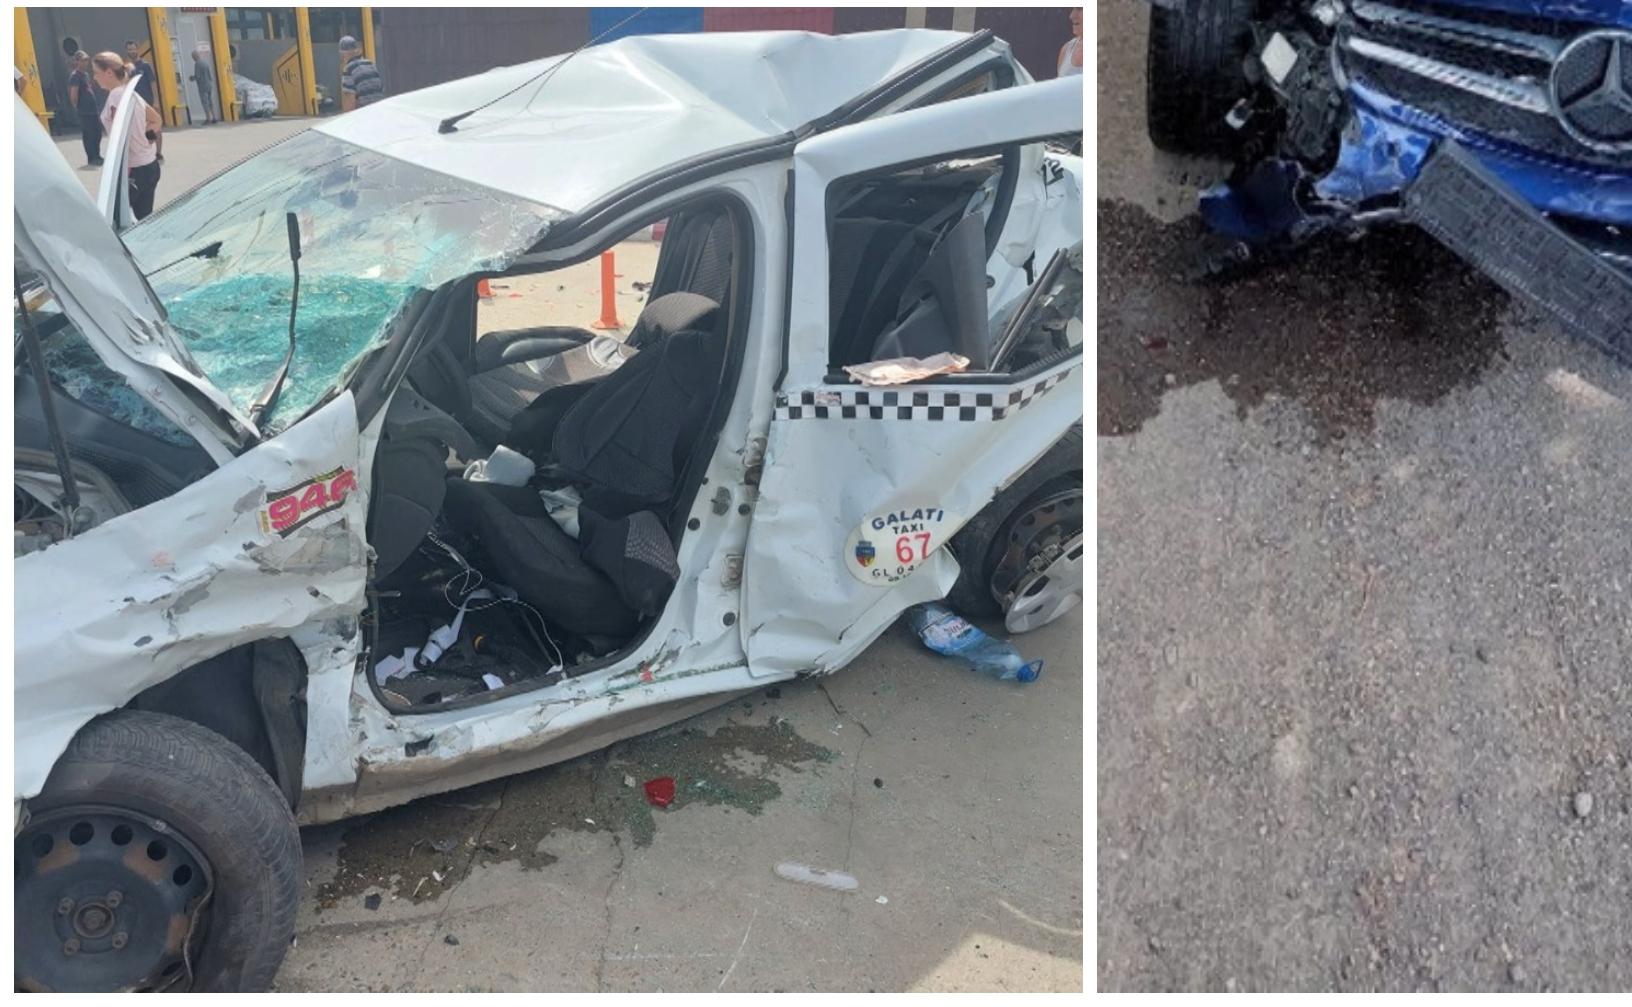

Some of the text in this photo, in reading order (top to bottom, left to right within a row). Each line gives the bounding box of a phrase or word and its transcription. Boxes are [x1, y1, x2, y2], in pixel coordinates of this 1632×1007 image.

[871, 508, 944, 531] GALATI
[892, 523, 924, 535] TAXI
[896, 532, 931, 564] 67
